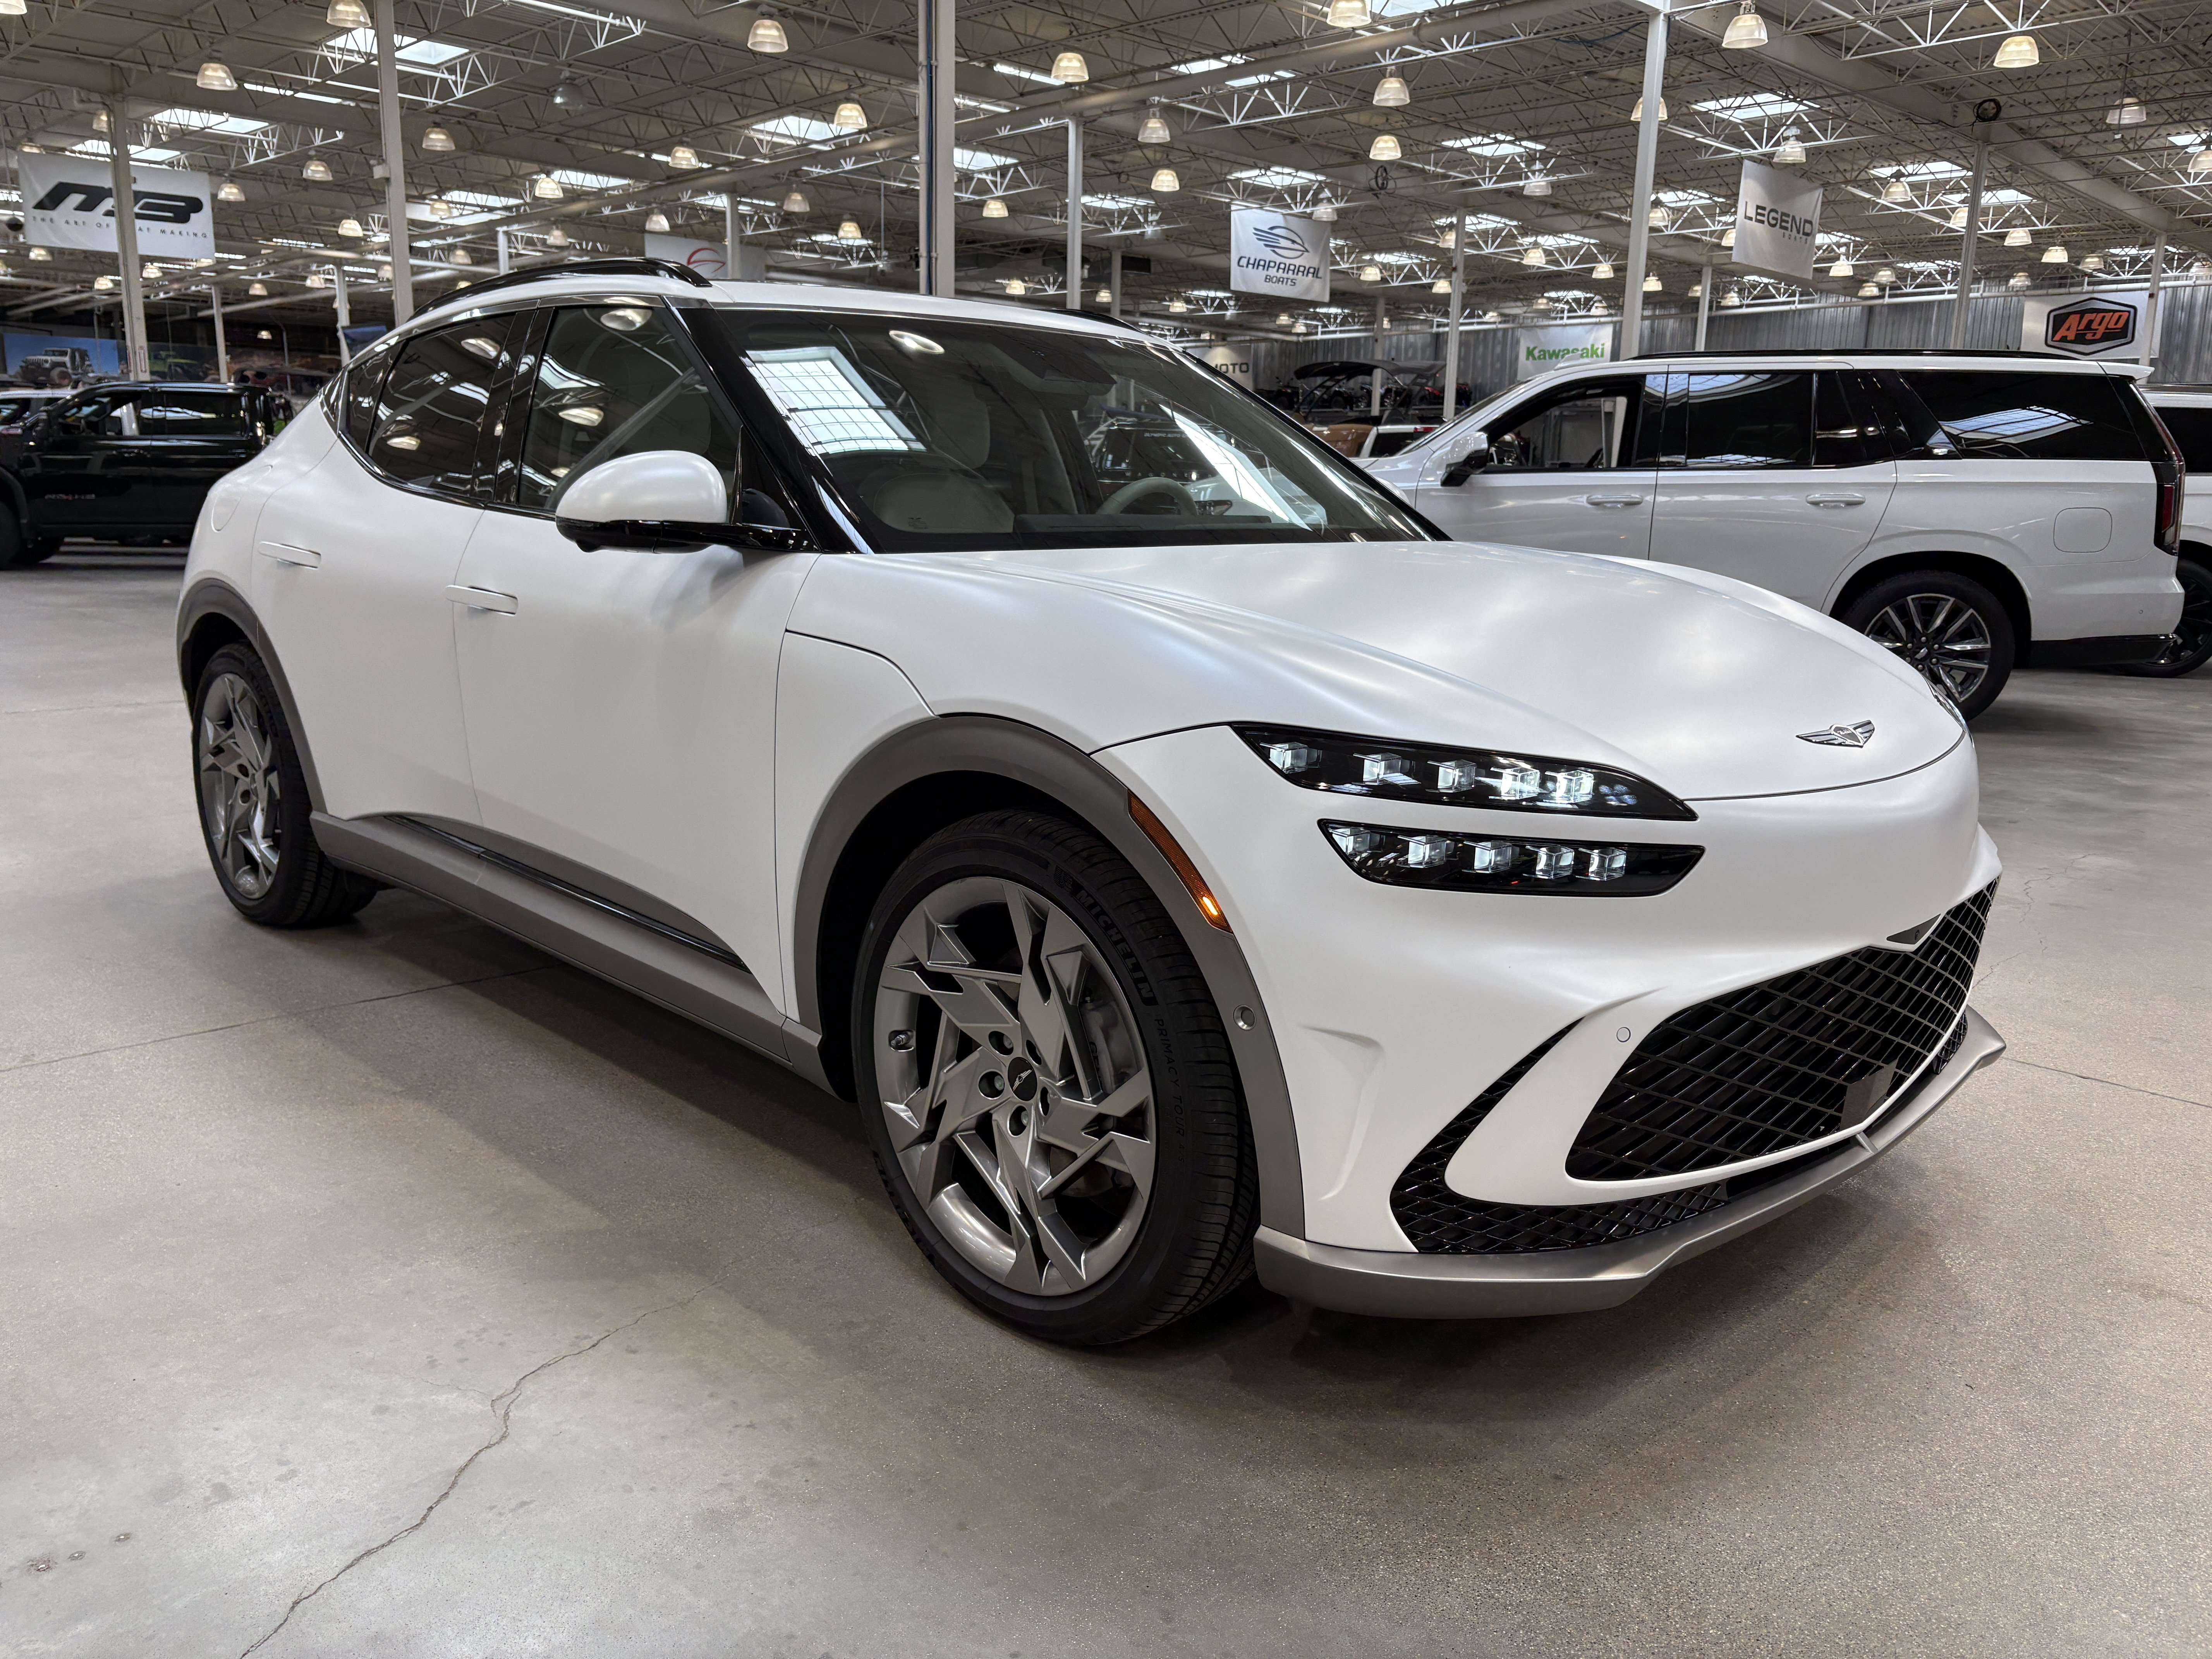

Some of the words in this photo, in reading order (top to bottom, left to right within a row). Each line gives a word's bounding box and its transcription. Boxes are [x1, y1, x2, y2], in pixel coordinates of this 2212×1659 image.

[160, 229, 208, 239] MAKING
[1743, 201, 1813, 237] LEGEND
[1237, 256, 1322, 279] CHAPARRAL
[1264, 275, 1297, 287] BOATS
[2052, 311, 2129, 342] Argo
[1074, 890, 1154, 999] MICHELIN
[1154, 1018, 1180, 1088] PRIMACY
[1173, 1096, 1185, 1137] TOUR
